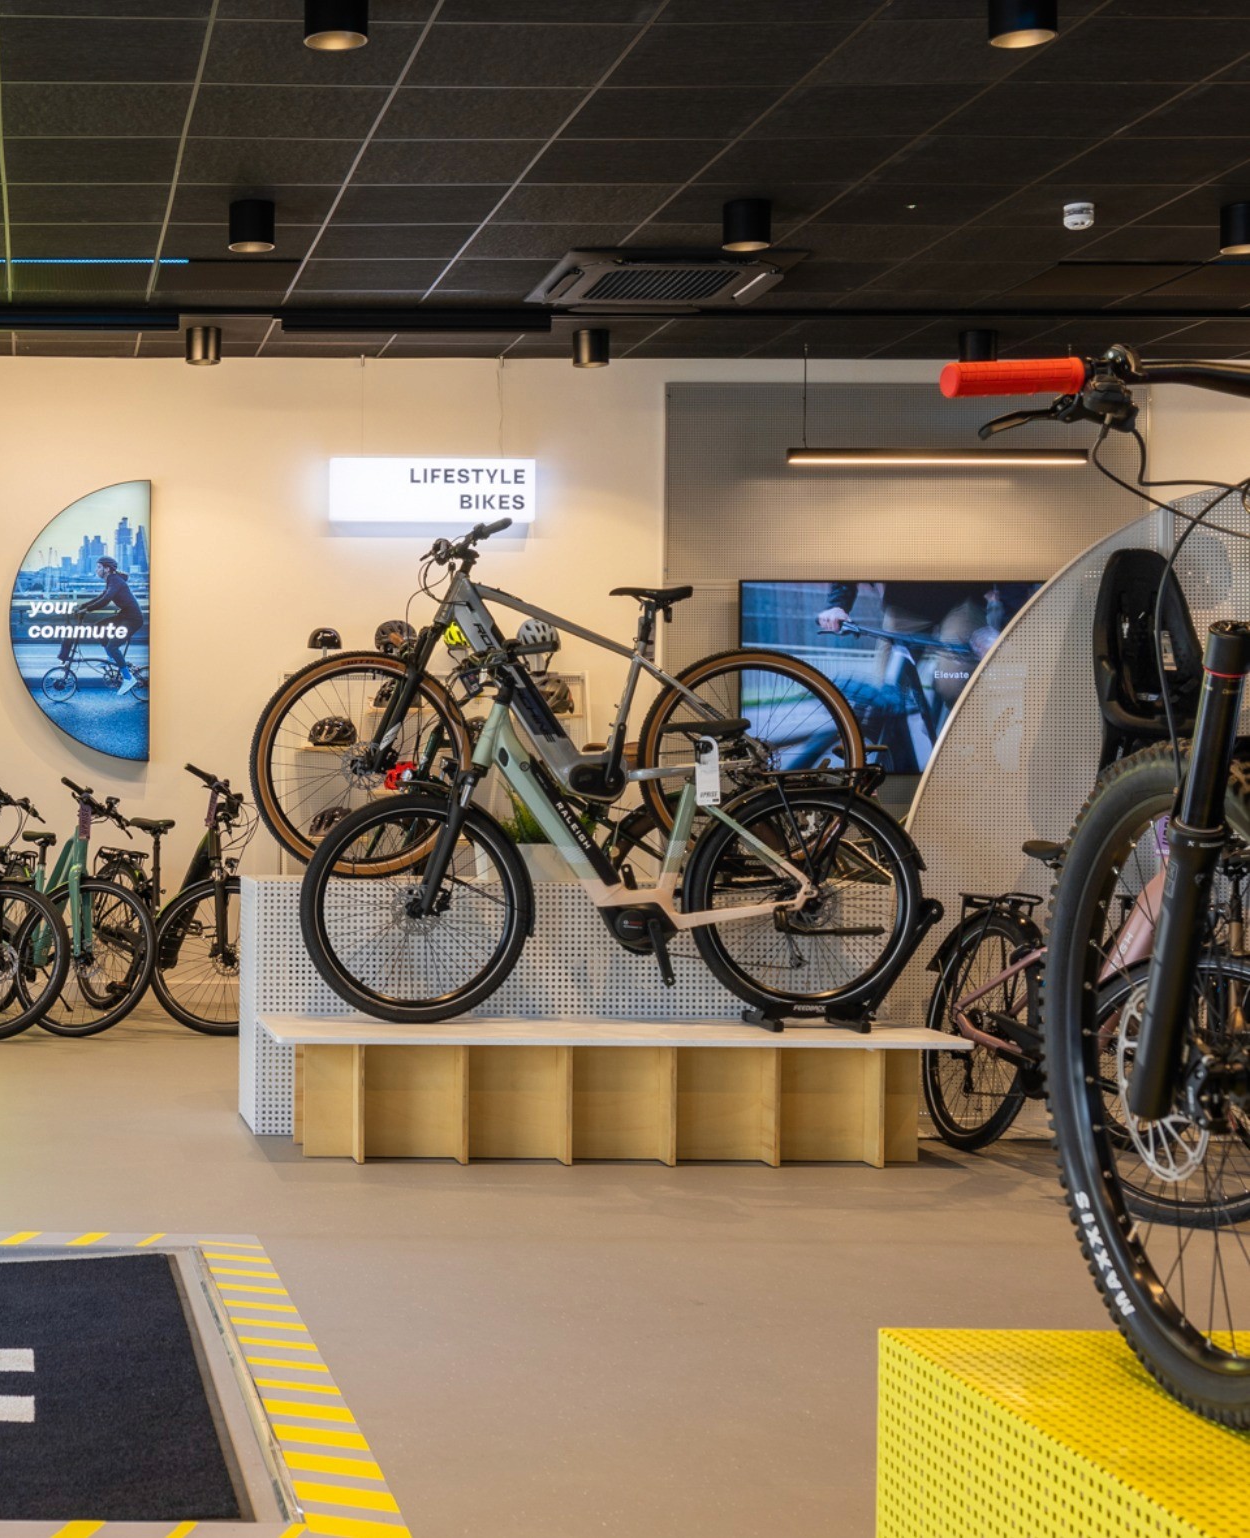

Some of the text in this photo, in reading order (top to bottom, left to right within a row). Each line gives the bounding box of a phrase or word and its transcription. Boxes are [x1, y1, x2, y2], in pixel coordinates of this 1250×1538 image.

[409, 467, 526, 485] LIFESTYLE
[459, 494, 526, 510] BIKES
[28, 600, 77, 618] your
[28, 623, 128, 640] commute
[934, 670, 970, 680] Elevate
[555, 801, 591, 850] RALEIGH
[1074, 1191, 1136, 1316] MAXXIS
